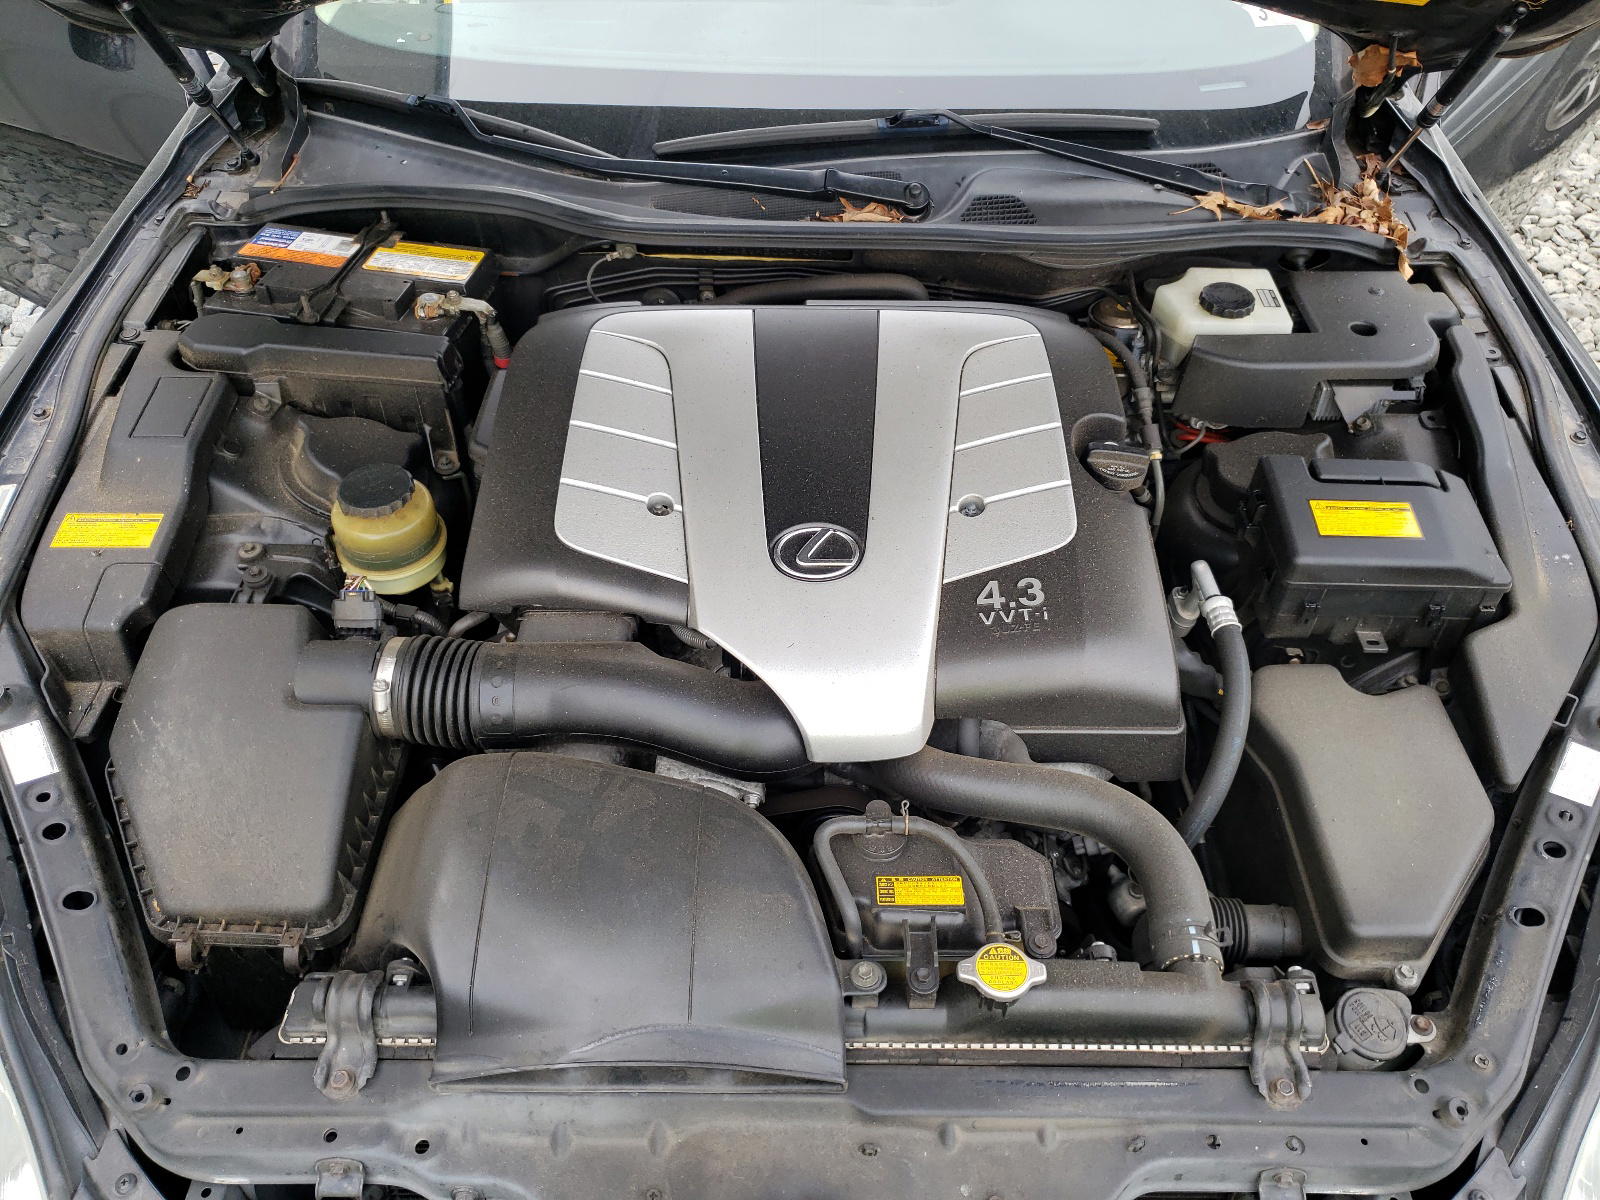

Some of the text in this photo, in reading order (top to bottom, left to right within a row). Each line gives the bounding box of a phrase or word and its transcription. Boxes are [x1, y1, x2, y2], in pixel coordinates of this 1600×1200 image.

[977, 577, 1045, 609] 4.3
[979, 607, 1049, 625] VVT-i
[983, 953, 1020, 961] CAUTION
